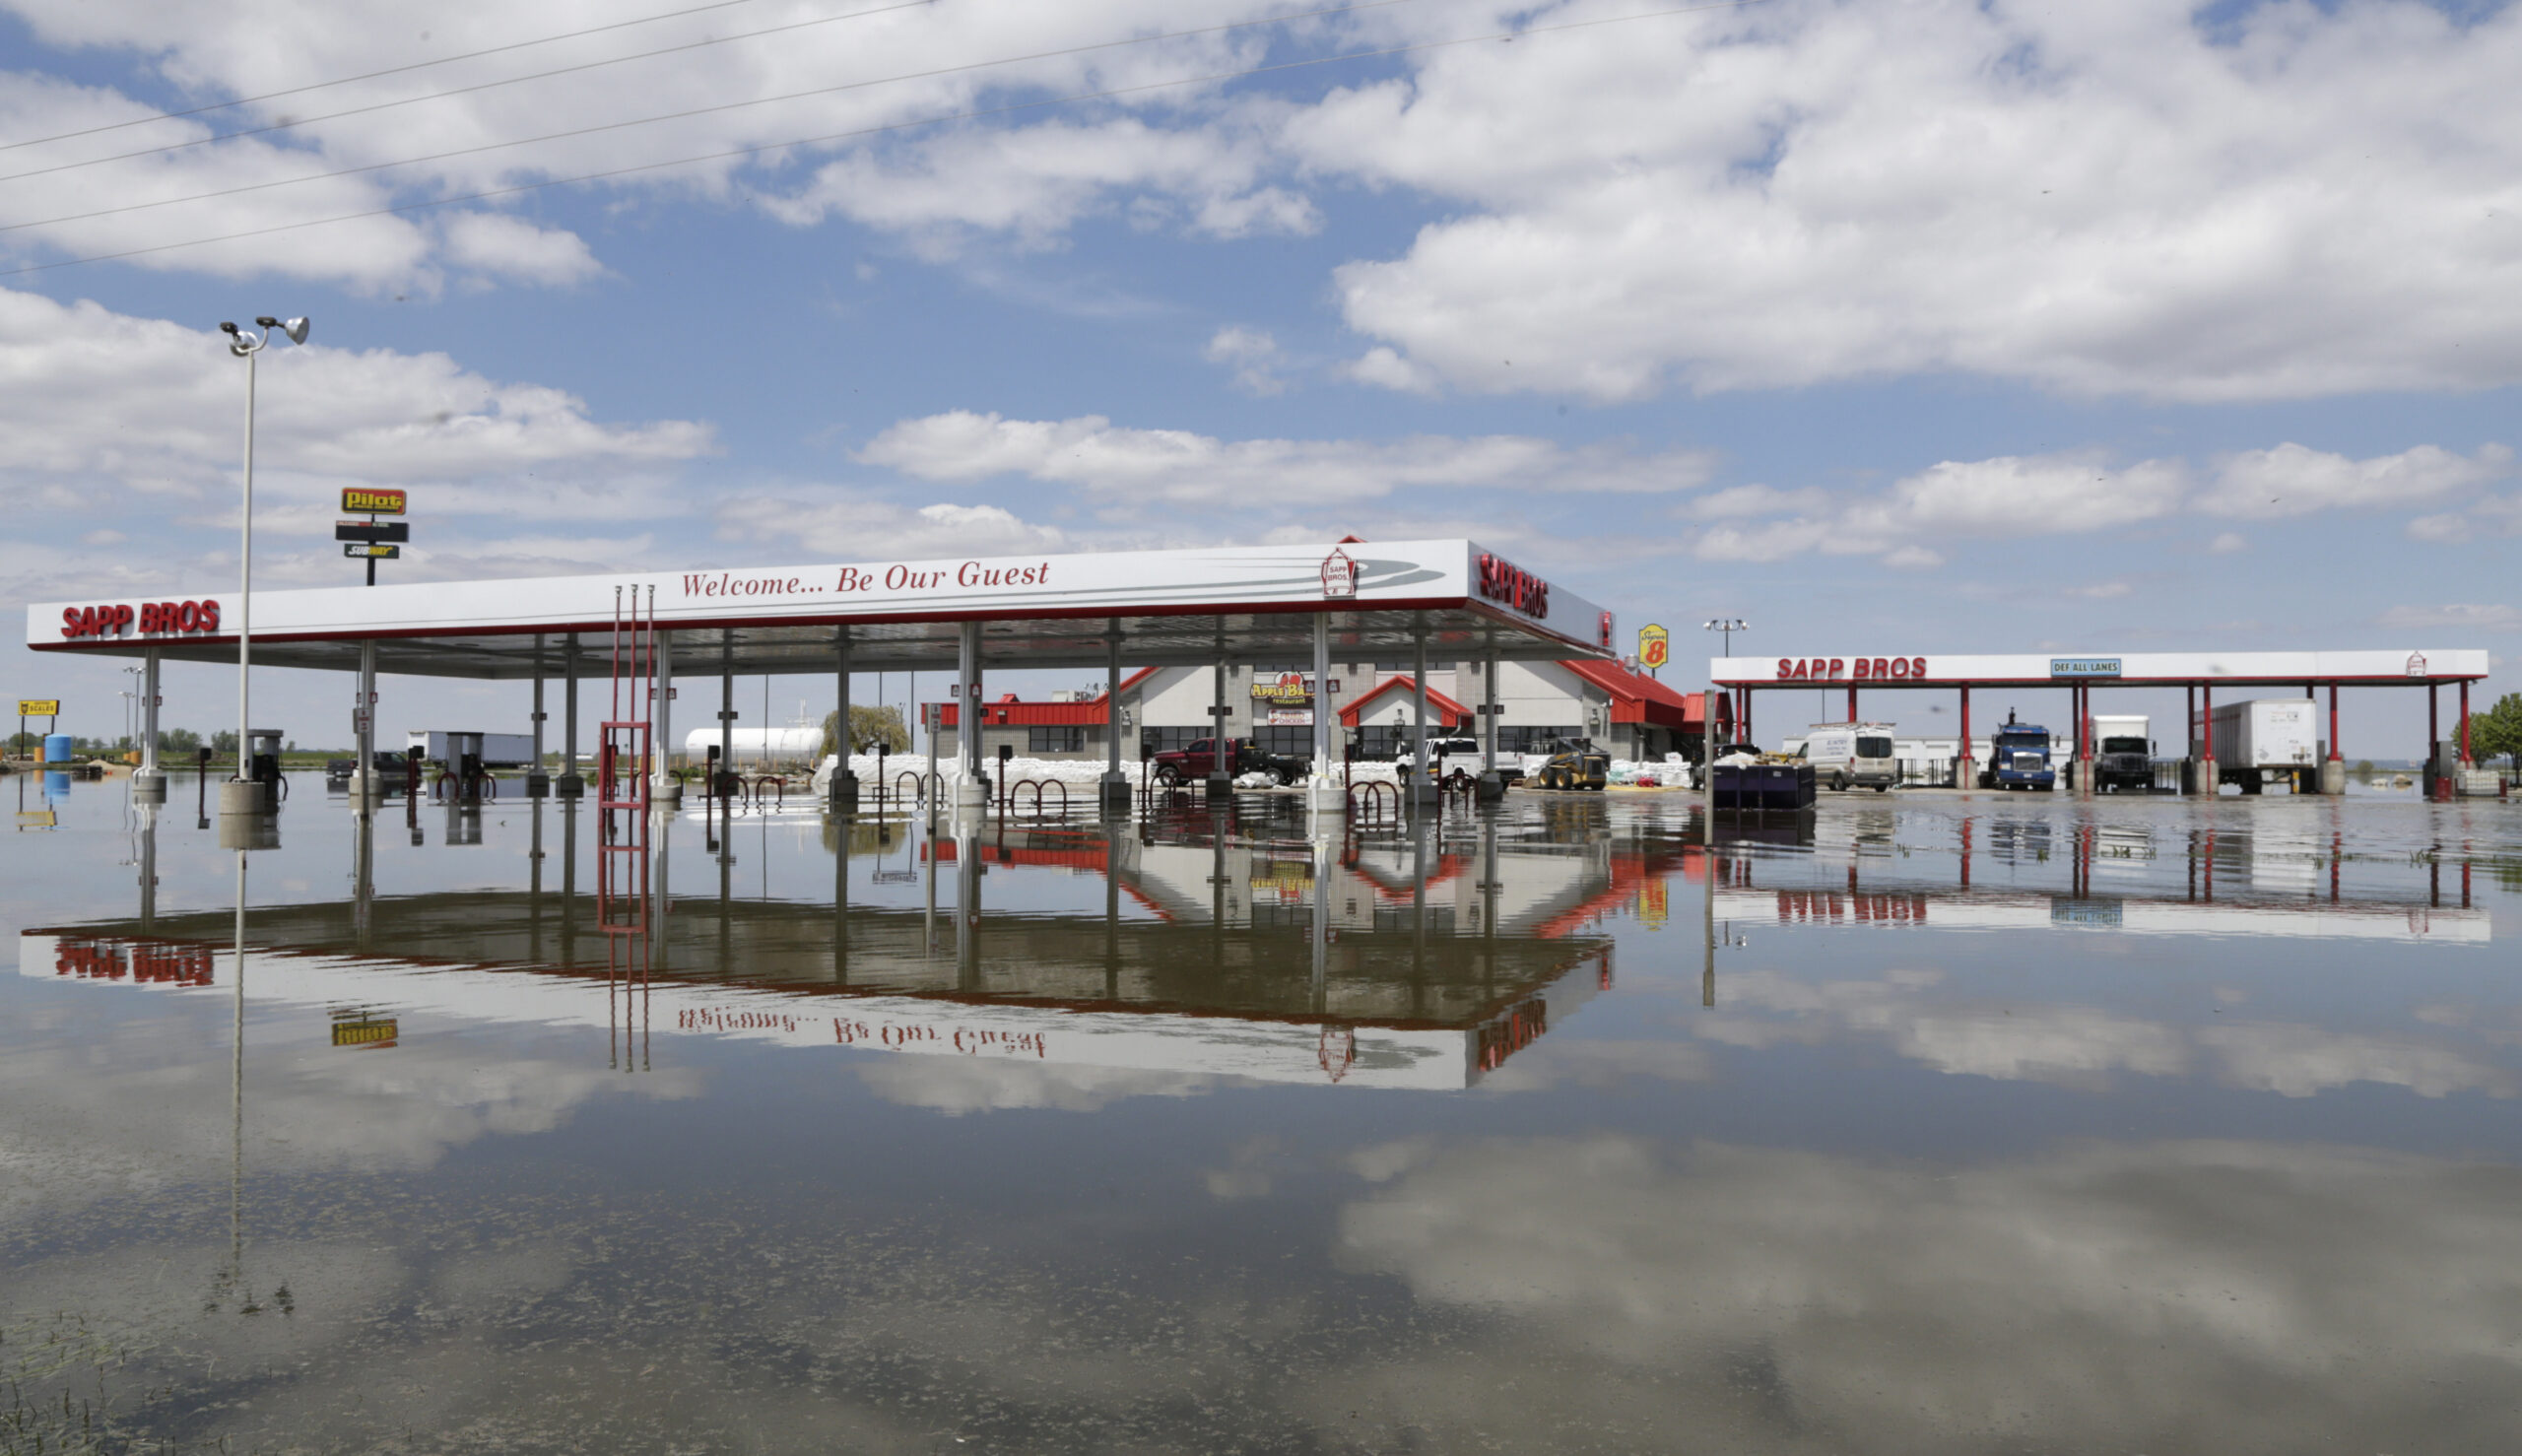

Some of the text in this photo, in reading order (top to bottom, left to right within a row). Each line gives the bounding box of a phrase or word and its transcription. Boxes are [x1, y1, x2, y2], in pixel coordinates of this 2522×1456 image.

[347, 492, 402, 508] Pilot
[348, 546, 393, 556] SUBWAY
[683, 562, 1049, 597] Welcome... Be Our Guest
[1481, 554, 1549, 619] SAPP BROS
[60, 599, 221, 638] SAPP BROS
[1646, 640, 1666, 663] 8
[1777, 657, 1927, 679] SAPP BROS
[2054, 663, 2070, 672] DEF
[2091, 662, 2118, 671] LANES
